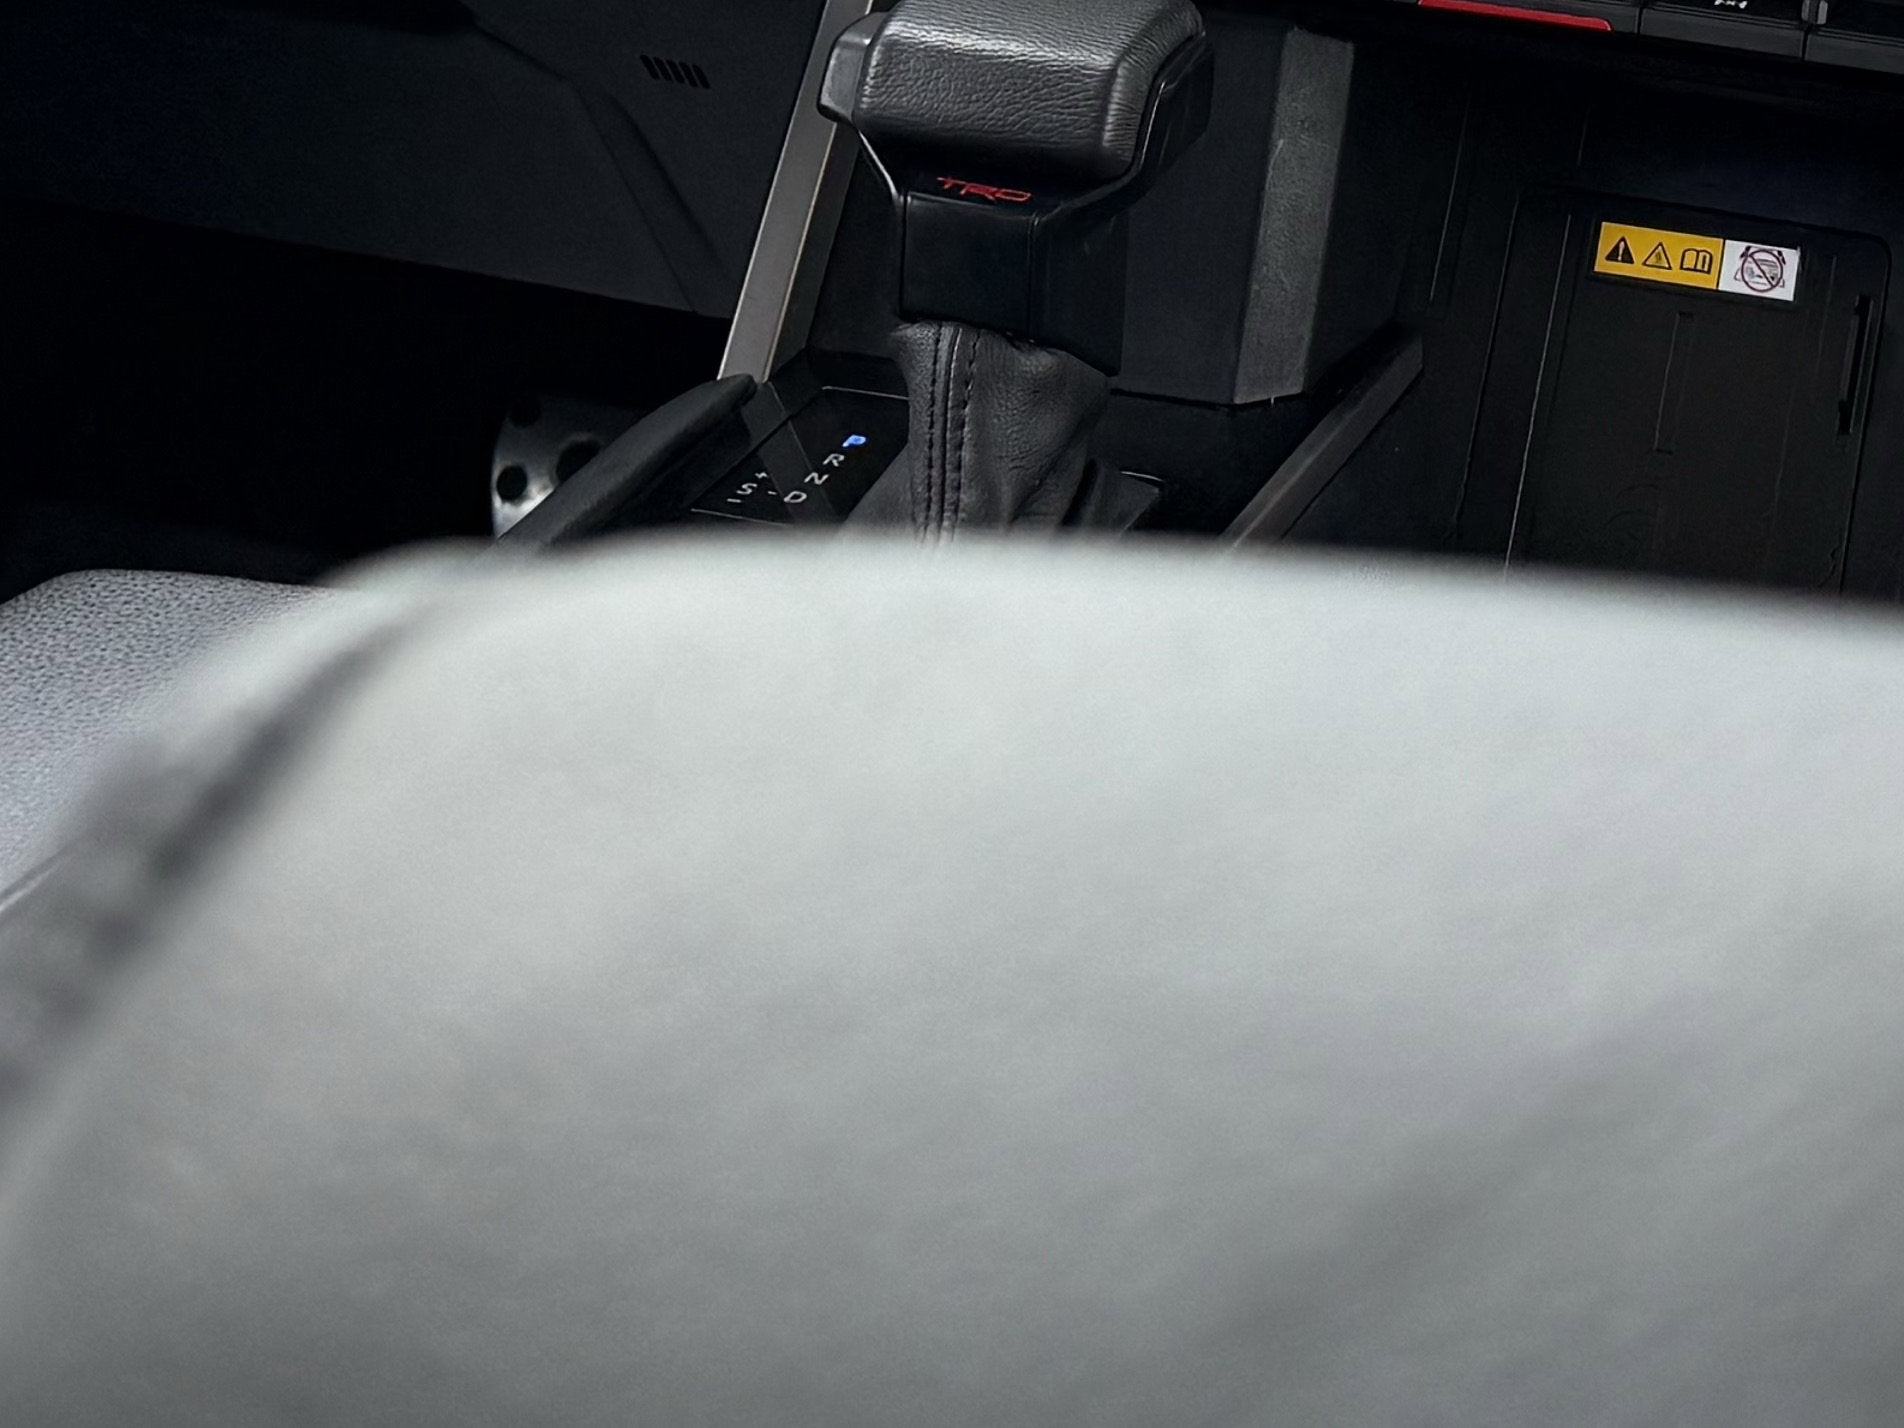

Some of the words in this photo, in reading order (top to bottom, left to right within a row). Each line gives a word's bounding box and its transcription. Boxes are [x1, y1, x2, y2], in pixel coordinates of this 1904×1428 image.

[936, 175, 1032, 203] TRD
[842, 434, 867, 448] P
[823, 452, 845, 467] R
[804, 471, 830, 486] N
[735, 482, 758, 495] S
[783, 490, 808, 504] D
